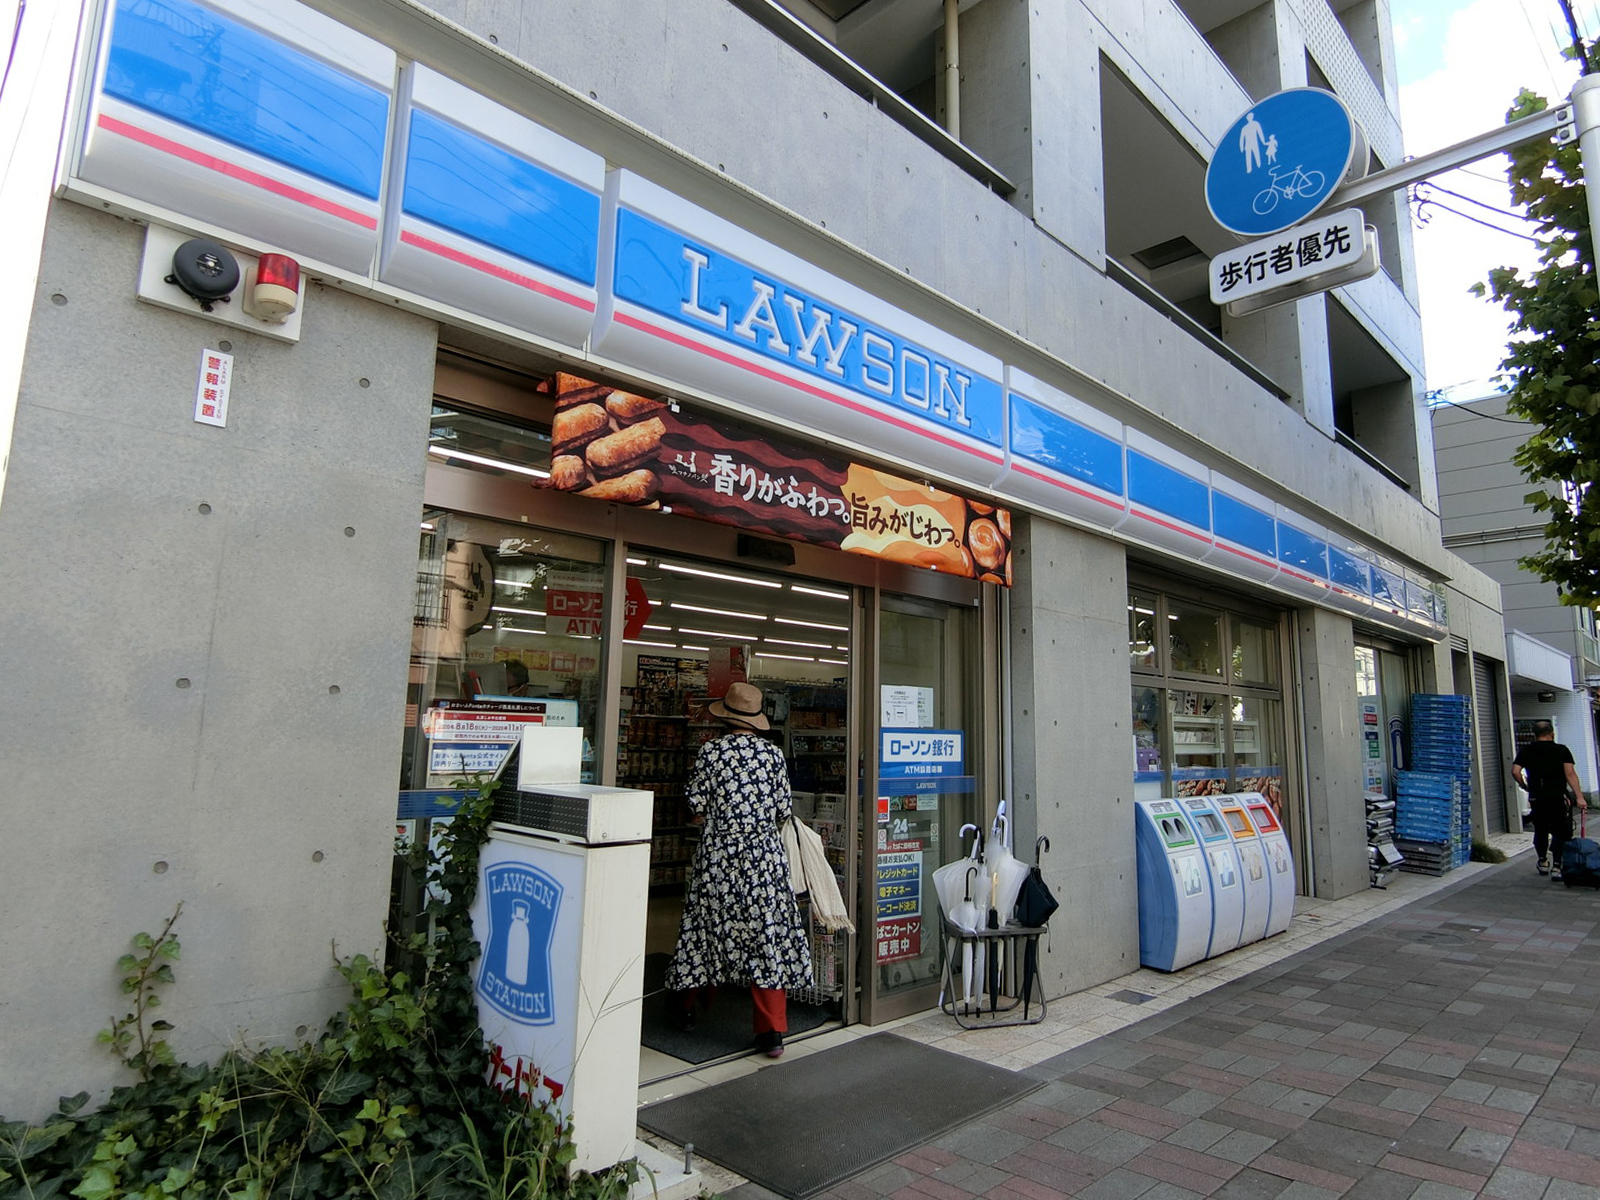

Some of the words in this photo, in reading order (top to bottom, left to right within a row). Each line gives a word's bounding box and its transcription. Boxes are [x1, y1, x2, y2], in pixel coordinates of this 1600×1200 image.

[1220, 225, 1351, 293] 歩行者優先
[681, 244, 972, 428] LAWSON
[202, 356, 221, 417] 警報装置
[709, 453, 851, 526] 香りがふわっ。
[850, 491, 961, 548] 旨みがじわっ。
[890, 739, 954, 757] ローソン銀行
[893, 818, 909, 833] 24
[491, 872, 554, 909] LAWSON
[879, 886, 912, 898] 電子マネー
[878, 937, 910, 957] 販売中
[484, 971, 546, 1014] STATION
